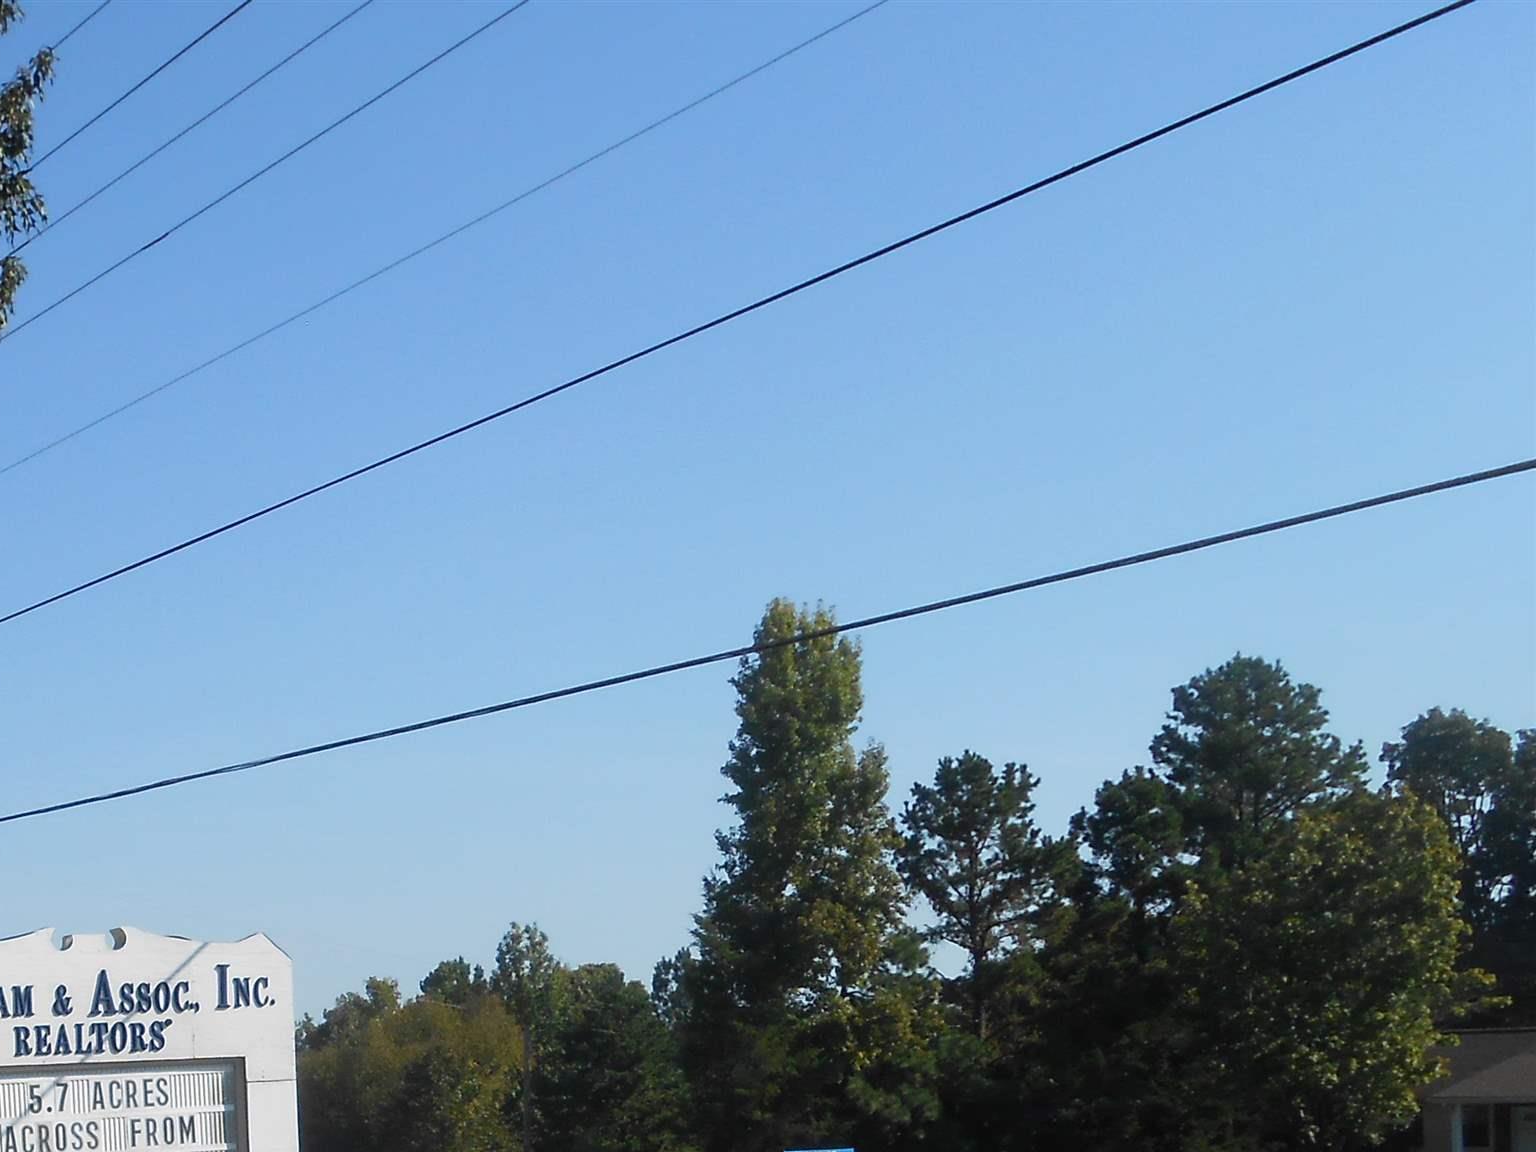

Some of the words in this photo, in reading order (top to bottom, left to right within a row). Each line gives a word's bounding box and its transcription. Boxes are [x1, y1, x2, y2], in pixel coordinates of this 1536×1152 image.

[52, 984, 74, 1016] &
[214, 964, 276, 1011] INC.
[29, 1083, 69, 1114] 5.7
[92, 1077, 170, 1111] ACRES
[131, 1115, 196, 1147] FROM
